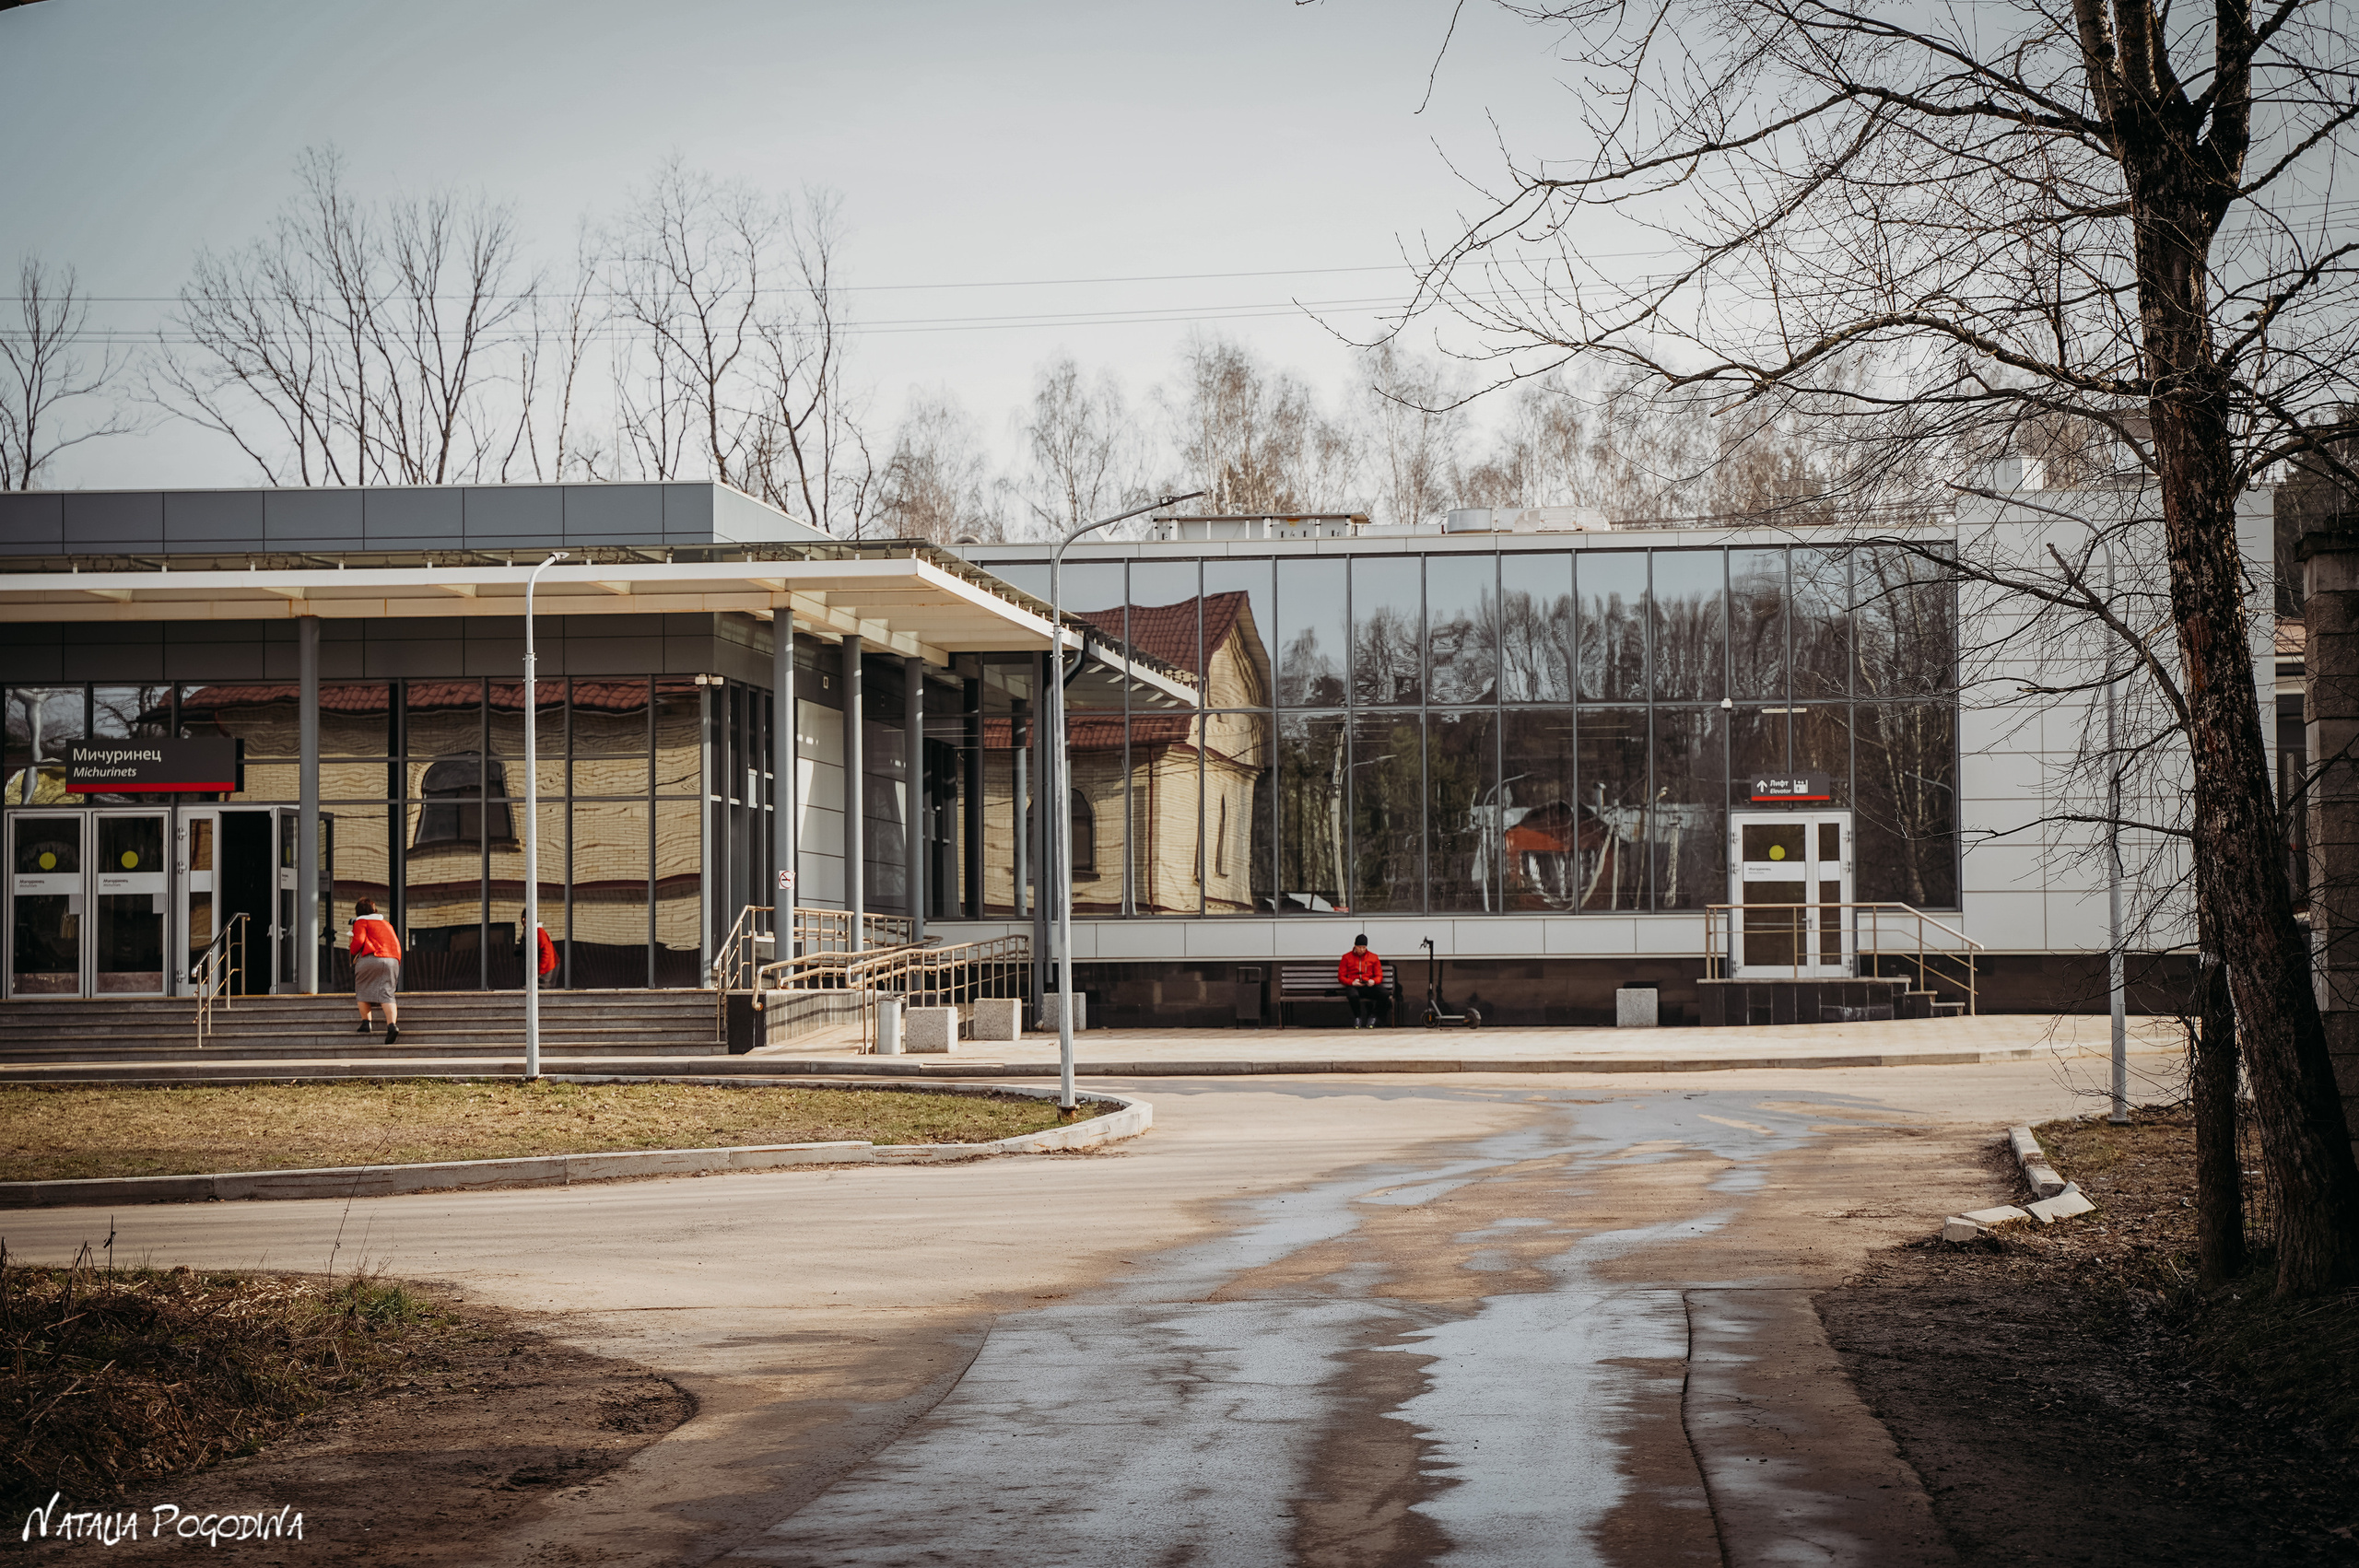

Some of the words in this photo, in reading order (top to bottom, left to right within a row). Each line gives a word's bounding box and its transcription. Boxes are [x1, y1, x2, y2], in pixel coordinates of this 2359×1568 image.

[73, 747, 161, 764] Мичуринец
[73, 766, 137, 778] Michurinets
[1769, 779, 1790, 788] Лифт
